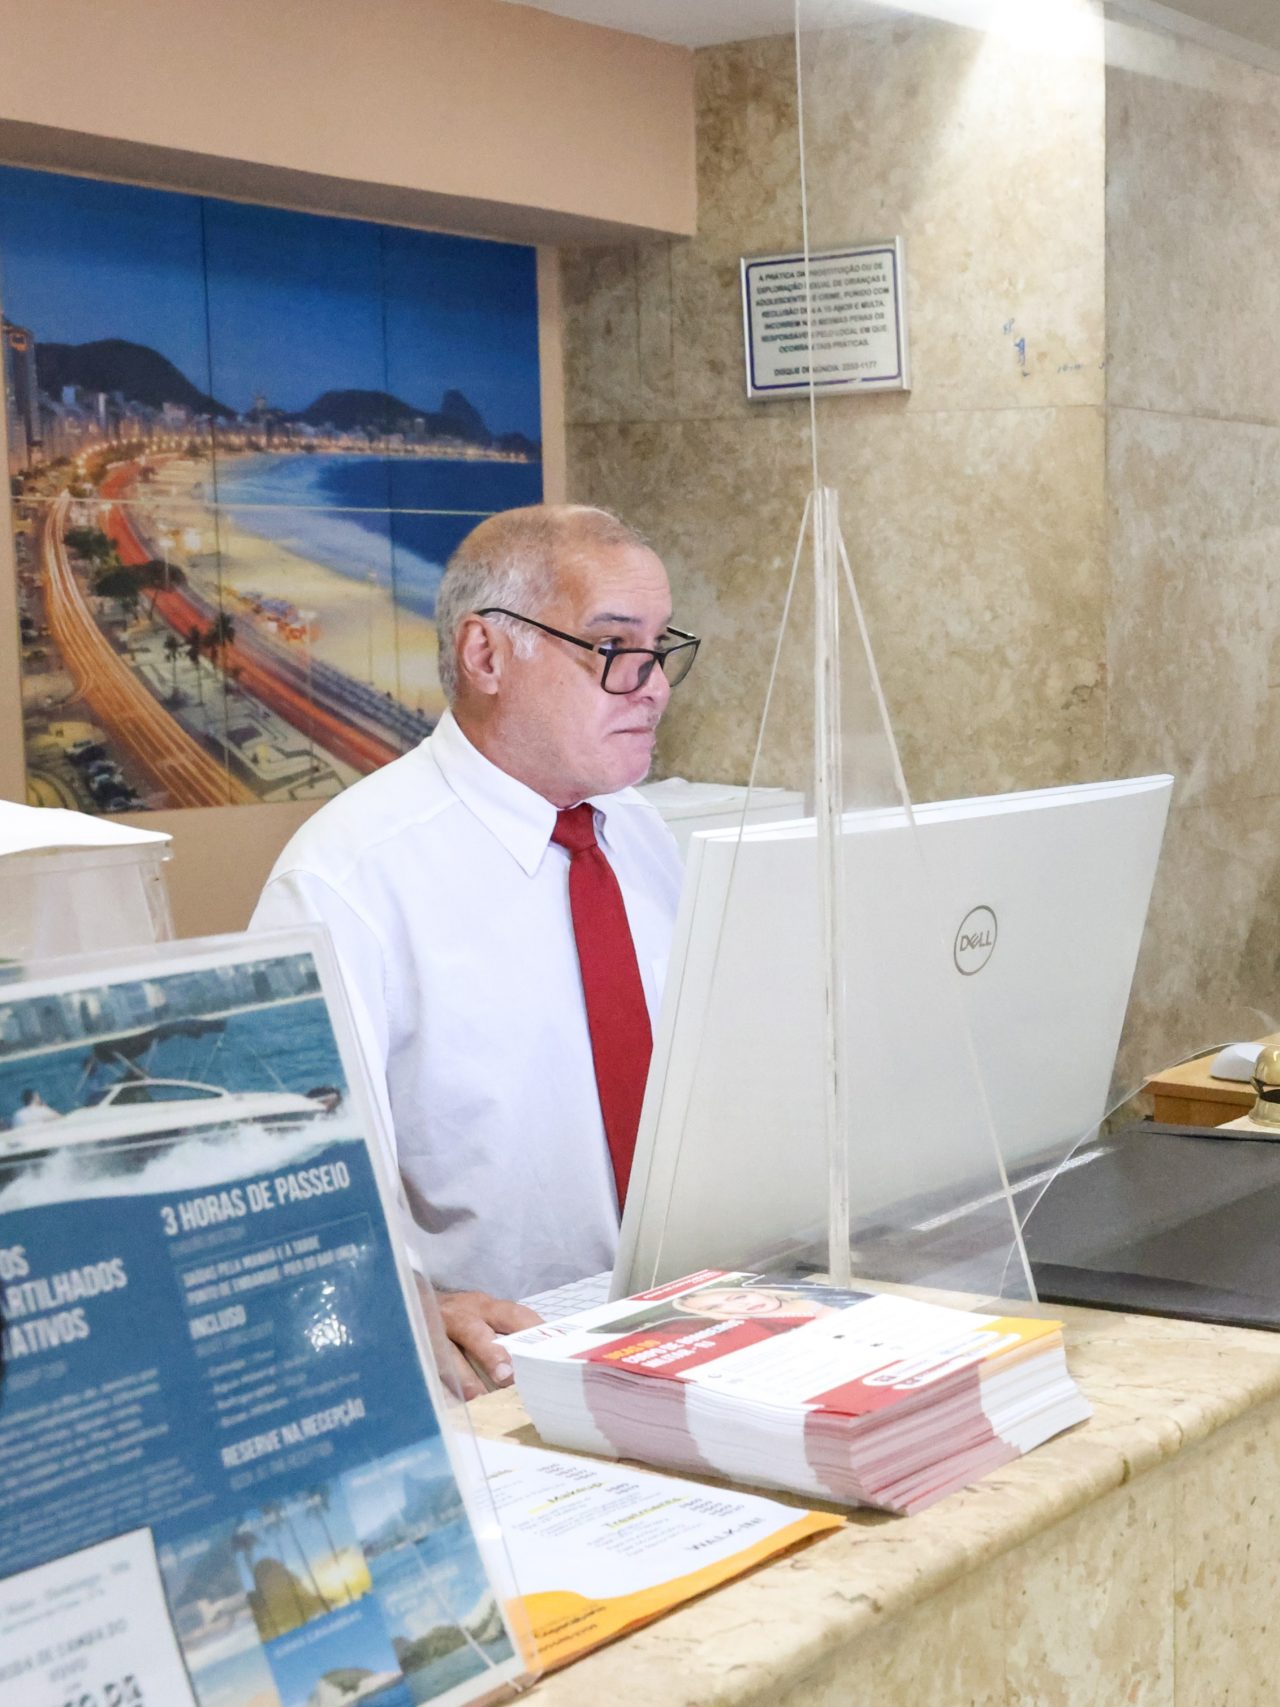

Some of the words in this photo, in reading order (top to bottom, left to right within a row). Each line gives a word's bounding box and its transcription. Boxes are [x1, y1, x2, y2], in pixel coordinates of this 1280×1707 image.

[960, 930, 992, 952] DELL
[160, 1205, 179, 1237] 3
[181, 1189, 247, 1232] HORAS
[249, 1181, 276, 1211] DE
[276, 1160, 351, 1206] PASSEIO
[4, 1306, 91, 1359] ATIVOS
[221, 1430, 282, 1468] RESERVE
[281, 1423, 301, 1447] NA
[300, 1397, 366, 1438] RECEPÇÃO
